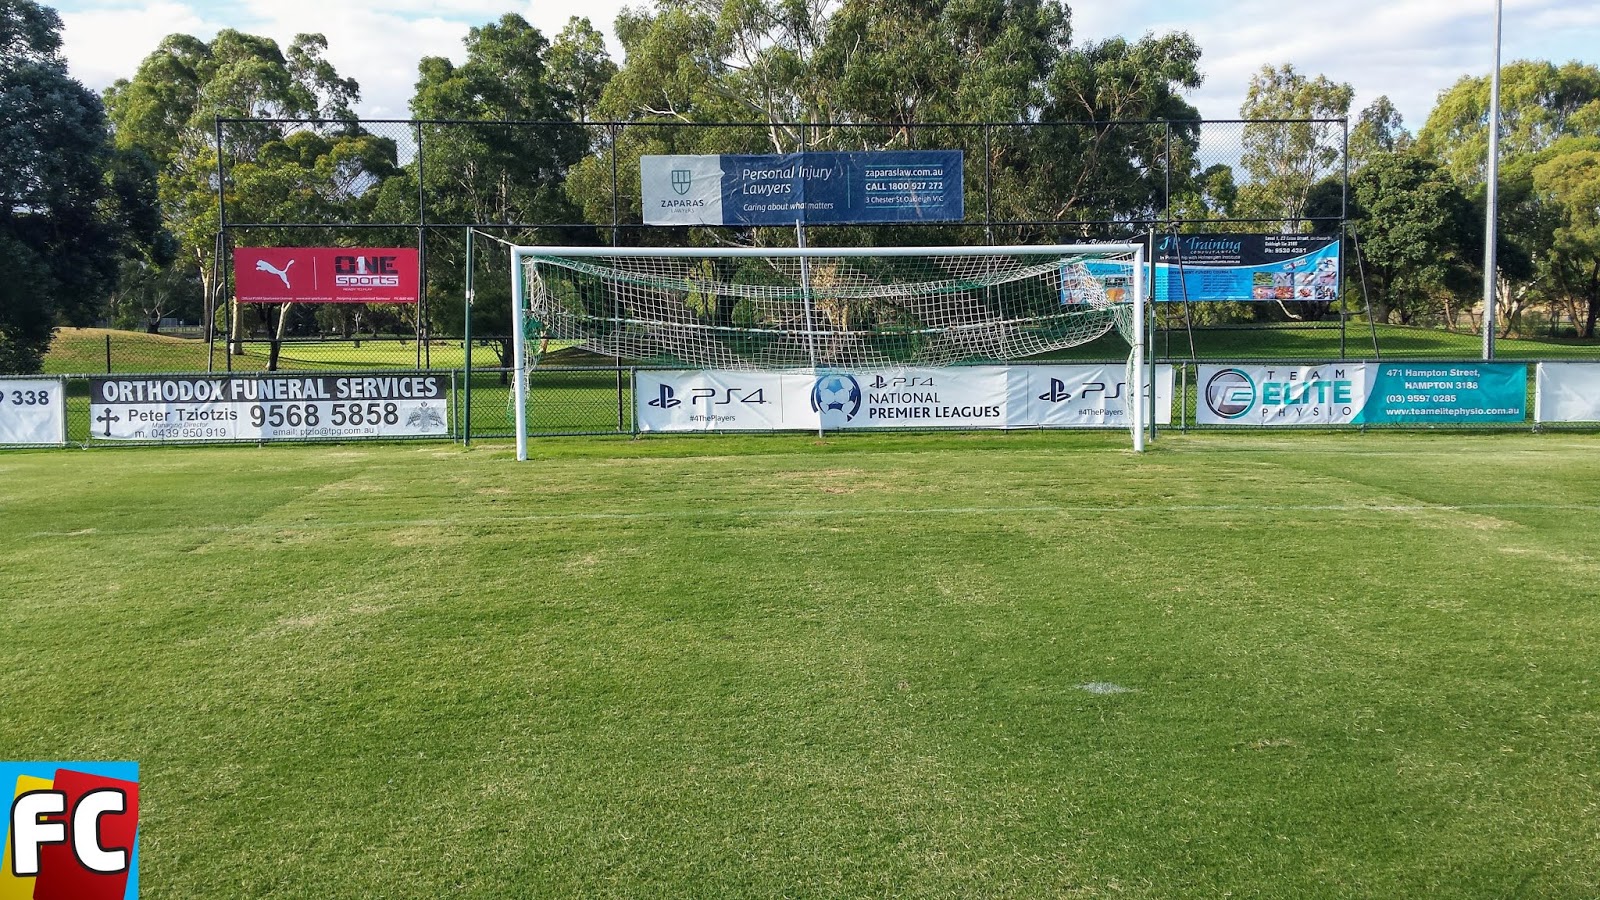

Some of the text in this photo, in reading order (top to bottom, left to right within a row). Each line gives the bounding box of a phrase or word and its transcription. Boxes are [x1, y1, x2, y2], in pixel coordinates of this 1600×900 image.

[742, 165, 832, 180] Personal Injury
[865, 168, 943, 178] zaparaslaw.com.au
[742, 183, 791, 196] Lawyers
[888, 182, 909, 190] 1800
[911, 182, 926, 190] 927
[661, 199, 704, 207] ZAPARAS
[743, 202, 834, 212] Caring about what matters
[1185, 236, 1241, 254] Training
[337, 277, 397, 286] sports
[1267, 369, 1345, 380] TEAM
[1405, 369, 1448, 378] Hampton
[1449, 369, 1480, 377] Street,
[891, 377, 934, 387] PS4
[102, 377, 438, 402] ORTHODOX FUNERAL SERVICES
[1262, 381, 1352, 405] ELITE
[11, 390, 49, 406] 338
[692, 388, 767, 405] PS4
[869, 392, 940, 404] NATIONAL
[1386, 395, 1405, 403] (03)
[128, 408, 238, 421] Peter Tziotzis
[250, 402, 399, 427] 9568 5858
[869, 406, 1000, 418] PREMIER LEAGUES
[1079, 408, 1123, 416] #4ThePlayers
[1262, 407, 1351, 417] PHYSIO
[1386, 408, 1520, 416] www.teamelitephysio.com.au
[134, 427, 226, 438] m. 0439 950 919
[272, 428, 298, 436] email:
